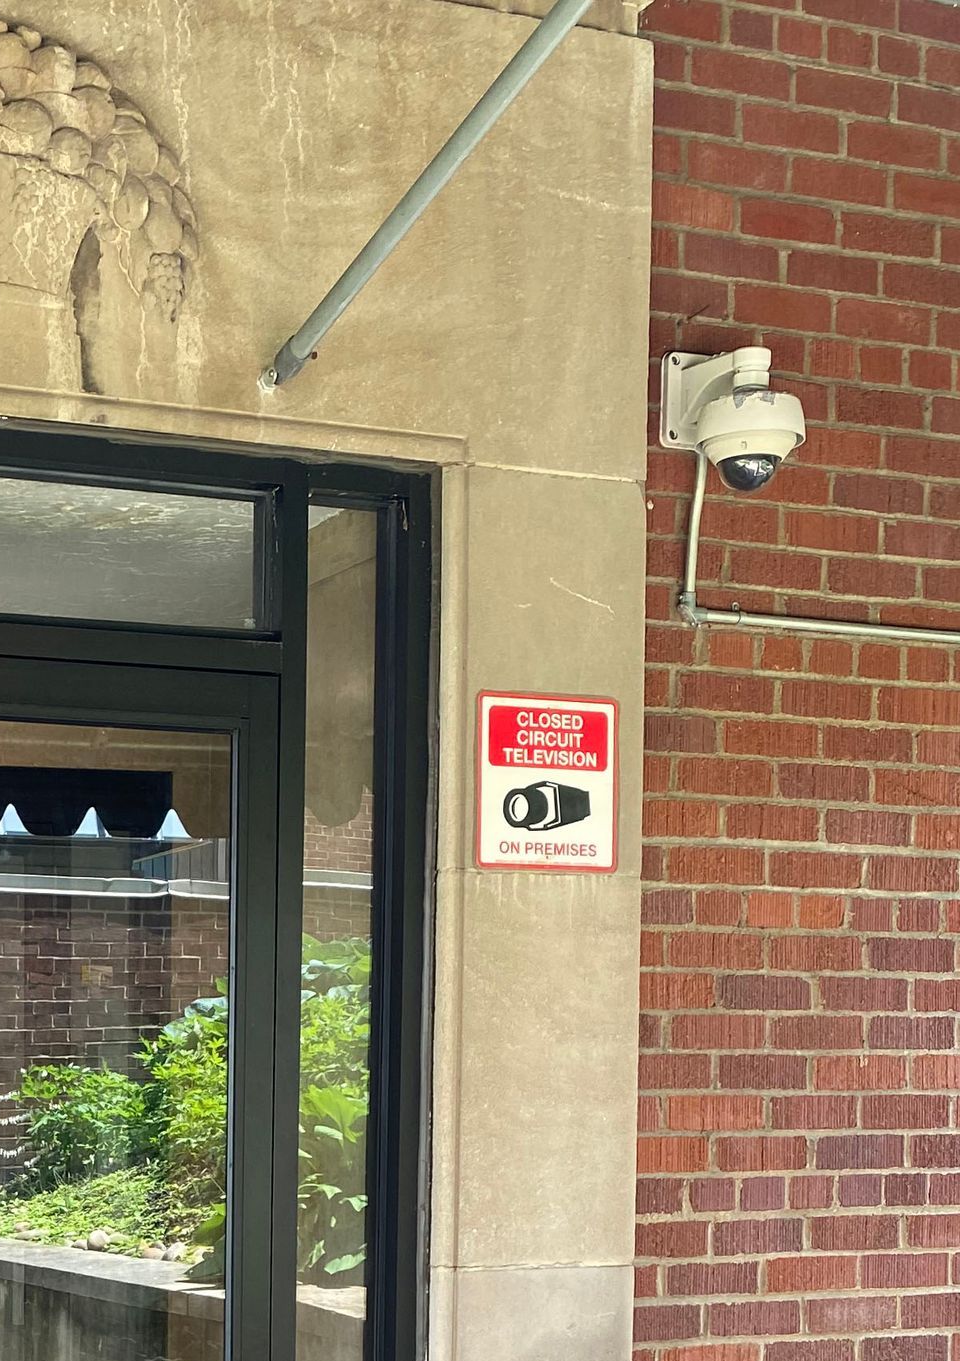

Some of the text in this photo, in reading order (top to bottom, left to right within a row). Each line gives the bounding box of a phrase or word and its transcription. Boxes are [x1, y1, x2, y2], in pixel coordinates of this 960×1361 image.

[516, 711, 584, 730] CLOSED
[516, 730, 584, 748] CIRCUIT
[502, 747, 597, 767] TELEVISION
[499, 841, 597, 857] ON PREMISES
